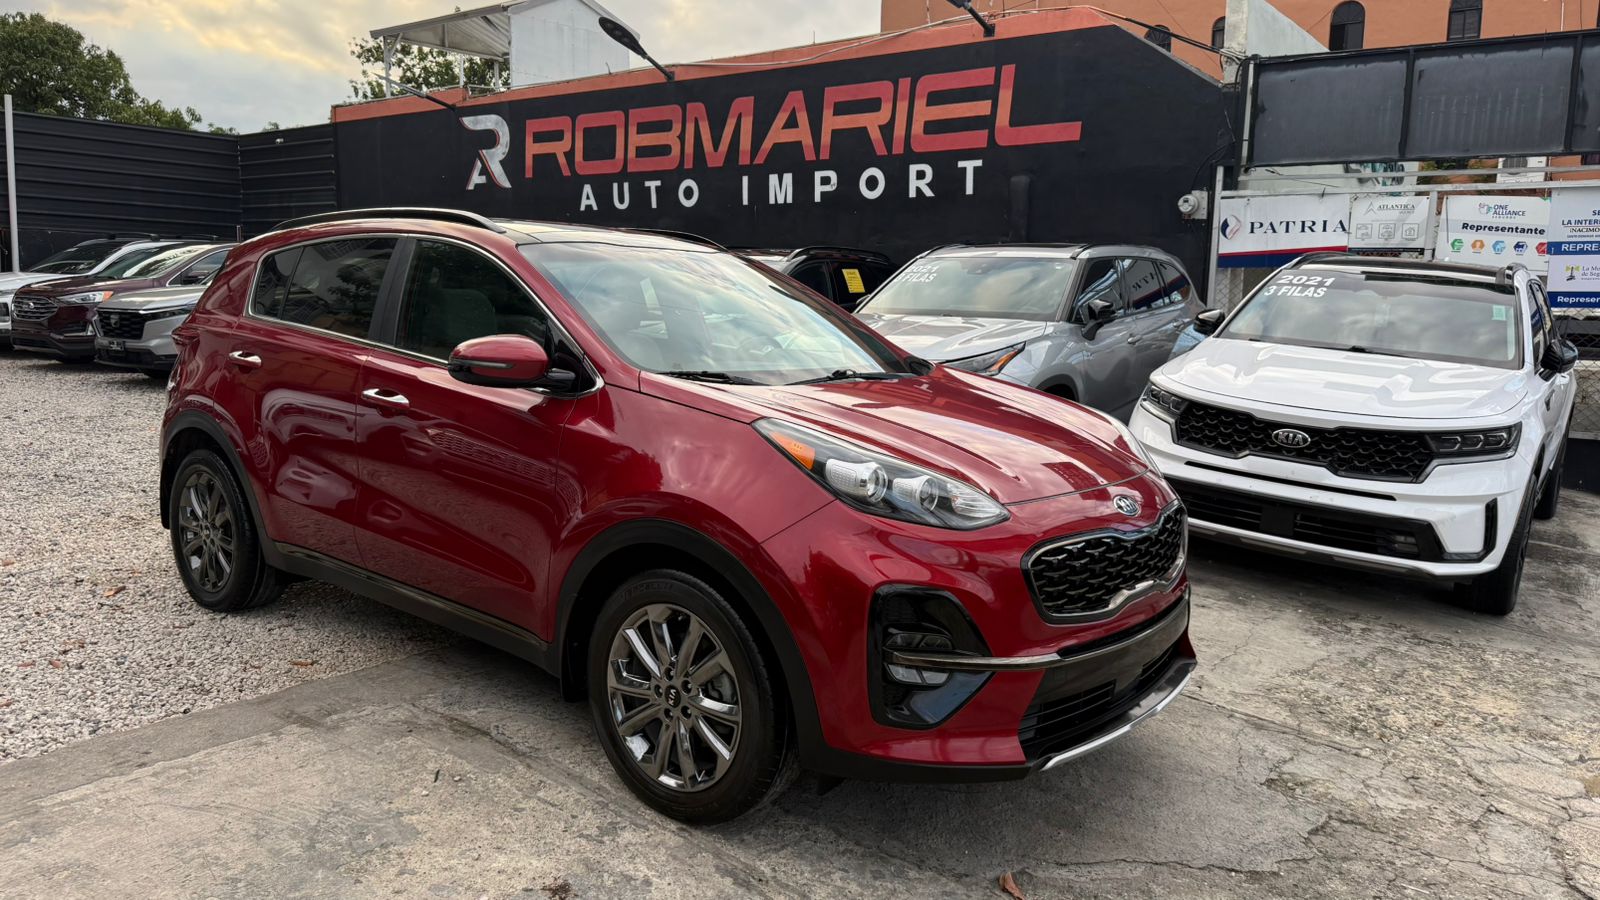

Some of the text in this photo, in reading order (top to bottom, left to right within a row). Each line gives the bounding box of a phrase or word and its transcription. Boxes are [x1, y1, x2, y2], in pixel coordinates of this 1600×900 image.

[524, 63, 1082, 178] ROBMARIEL
[579, 159, 984, 212] AUTO IMPORT
[1248, 219, 1348, 234] PATRIA
[1461, 222, 1546, 235] Representante
[1574, 218, 1600, 226] INTER
[1561, 243, 1600, 252] REPRE
[1276, 275, 1336, 287] 2021
[1264, 285, 1328, 298] 3 FILAS
